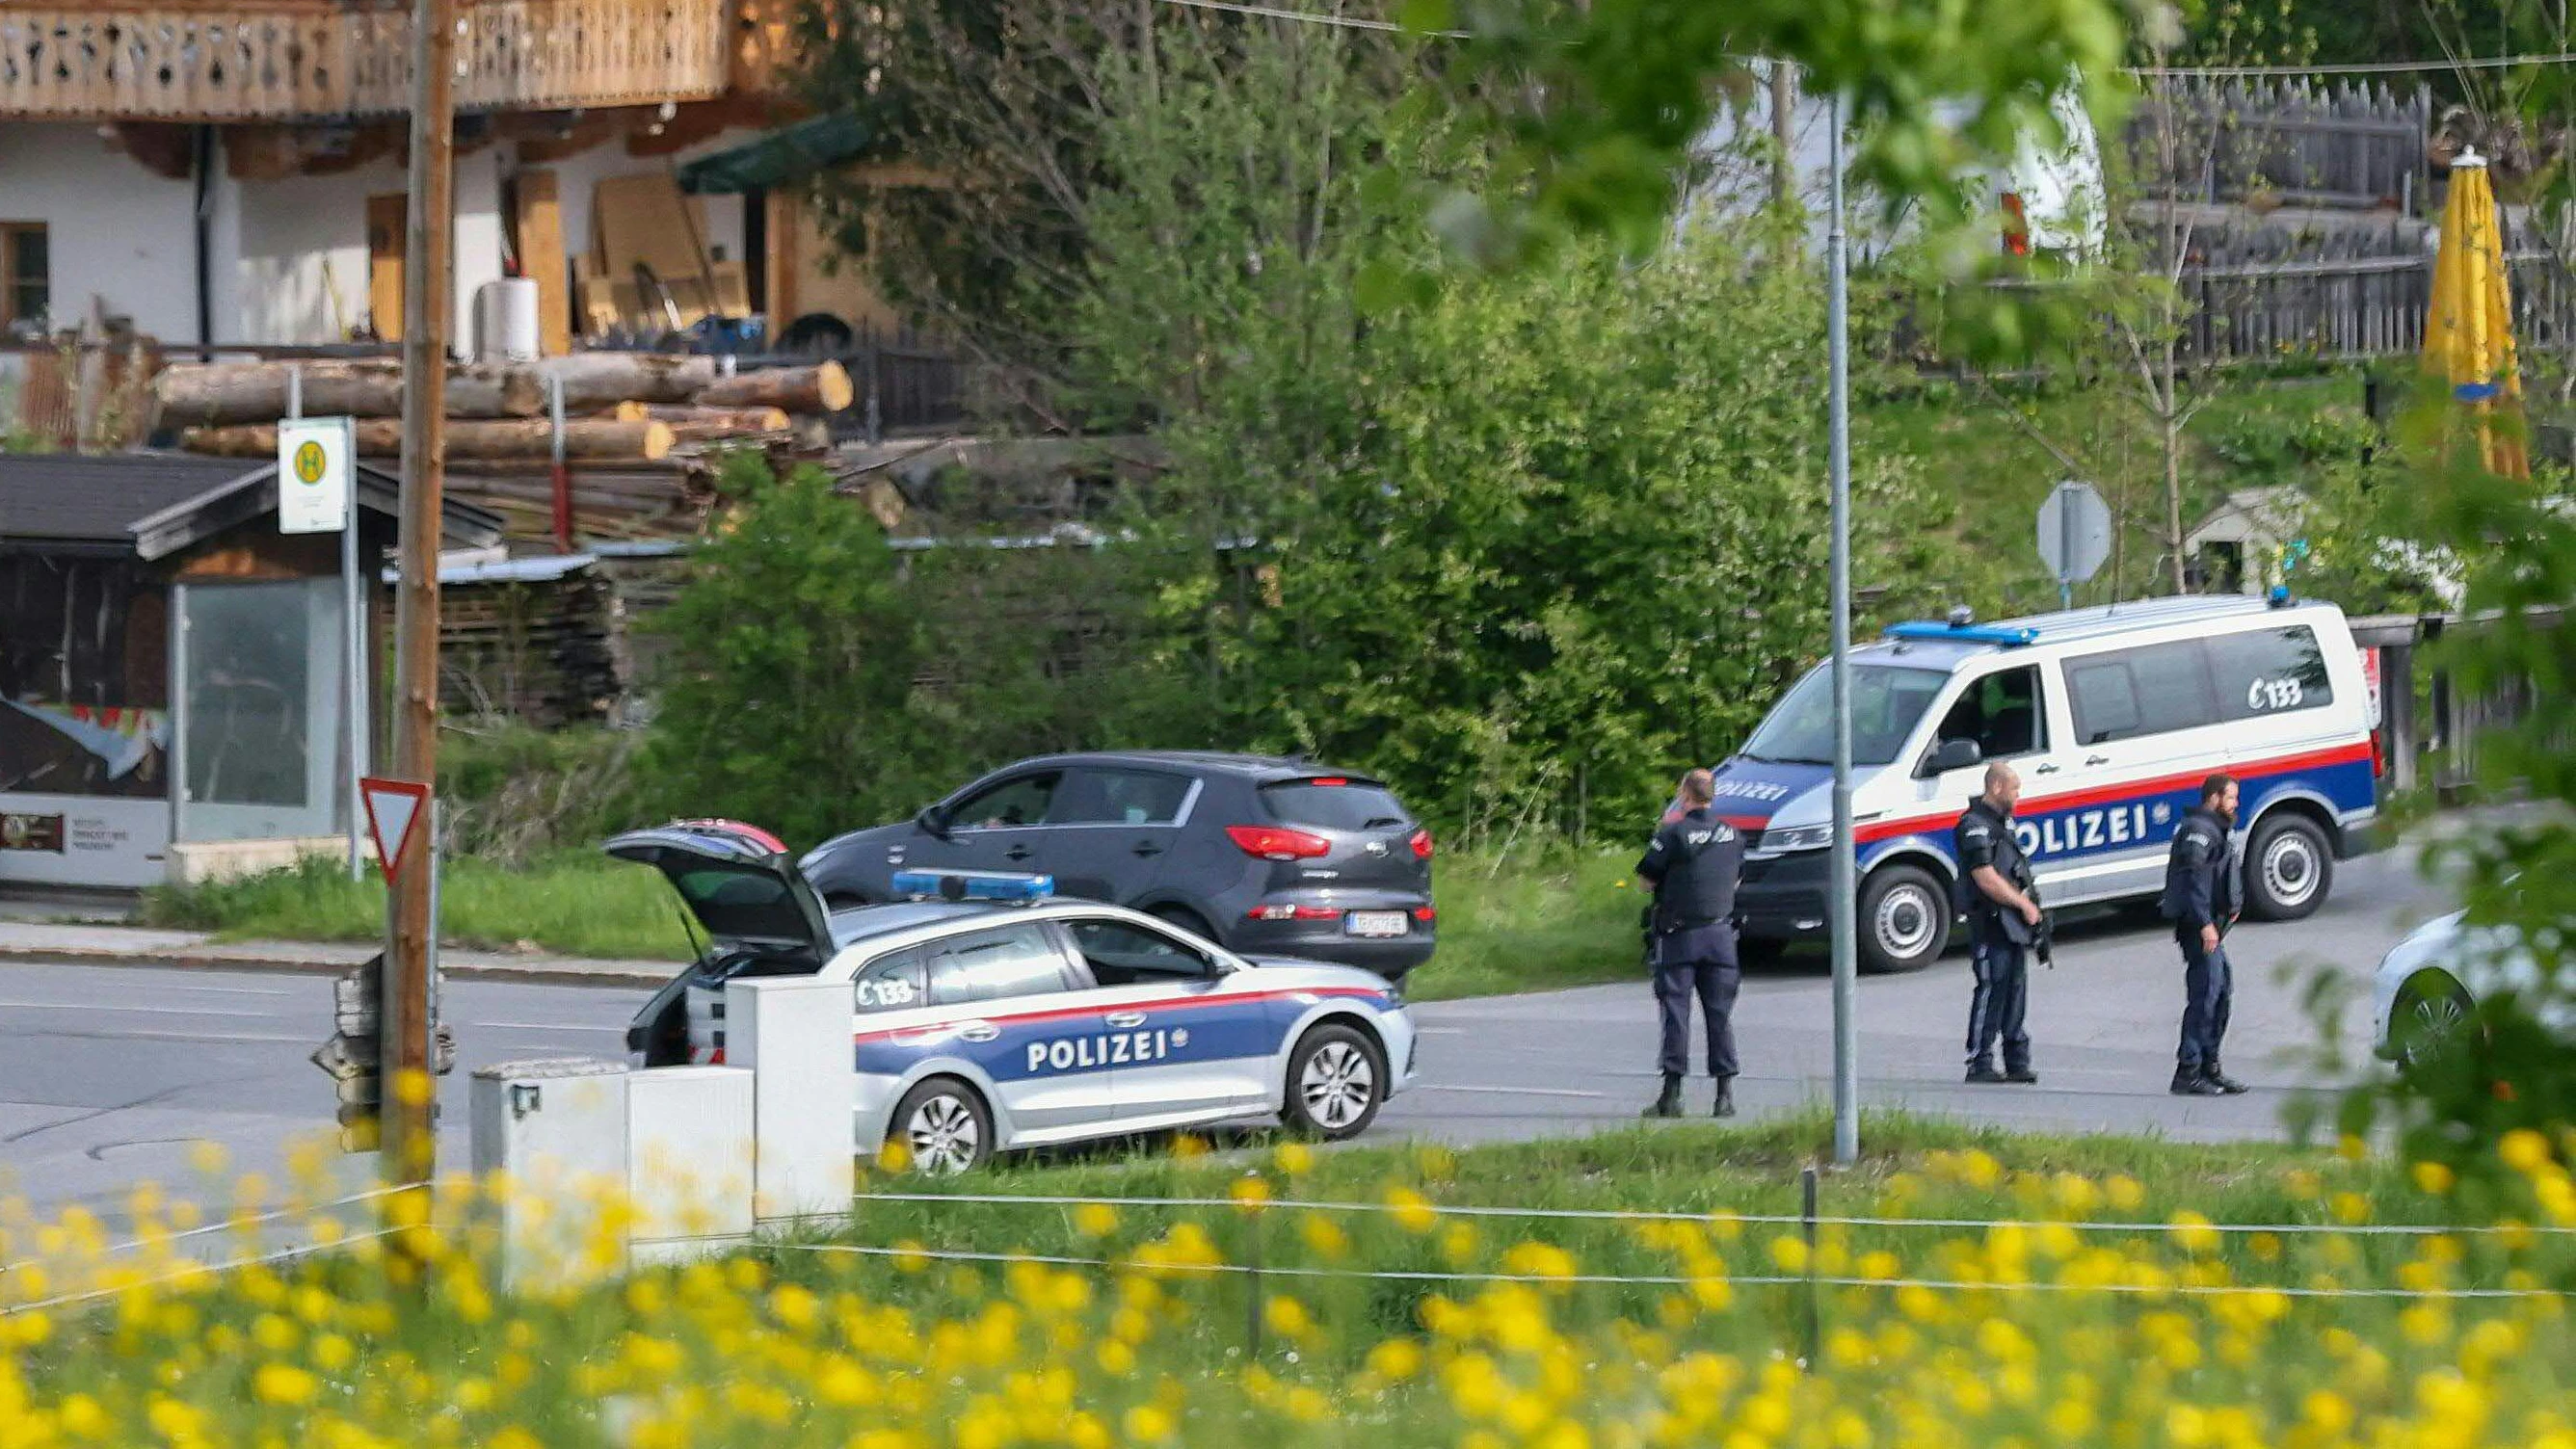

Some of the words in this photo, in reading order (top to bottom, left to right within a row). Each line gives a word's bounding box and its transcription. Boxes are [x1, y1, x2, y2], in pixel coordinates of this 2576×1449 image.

[1713, 779, 1789, 802] OLIZEI
[2006, 804, 2147, 857] OLIZEI
[1027, 1029, 1167, 1072] POLIZEI
